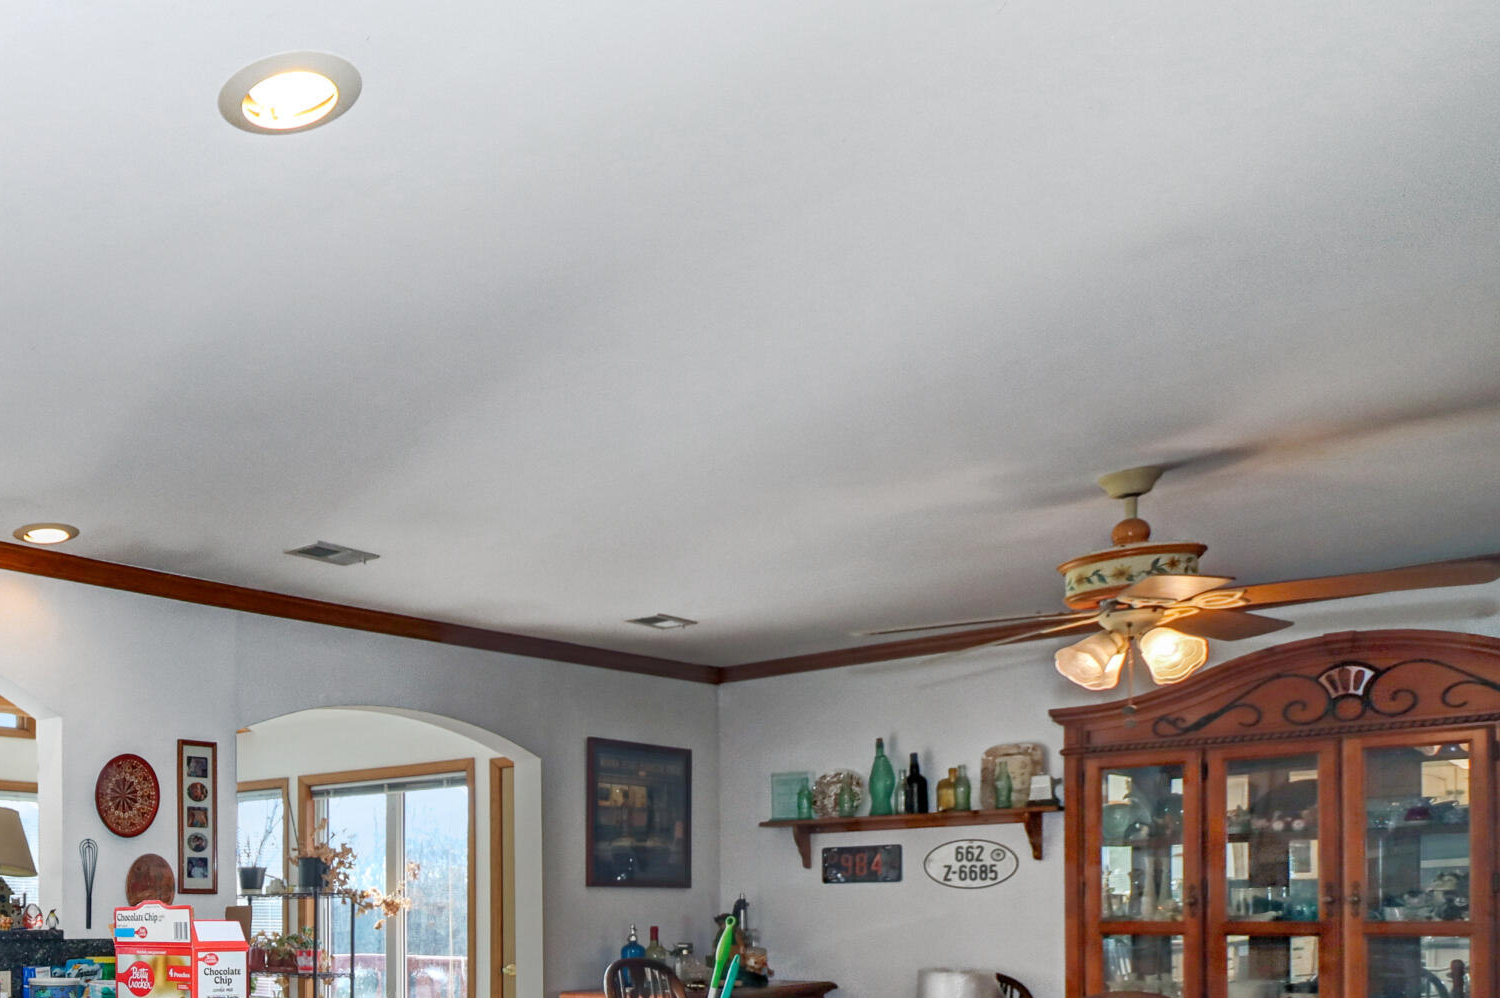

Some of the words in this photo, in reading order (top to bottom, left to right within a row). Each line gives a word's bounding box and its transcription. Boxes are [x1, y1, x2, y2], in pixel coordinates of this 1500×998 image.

[955, 845, 984, 862] 662
[840, 852, 883, 877] 984
[943, 864, 998, 882] Z-6685
[116, 913, 143, 922] Chocolate
[144, 912, 158, 923] Chip
[130, 966, 149, 980] Betty
[204, 967, 242, 976] Chocolate
[128, 976, 152, 990] Crocker
[214, 975, 233, 986] Chip
